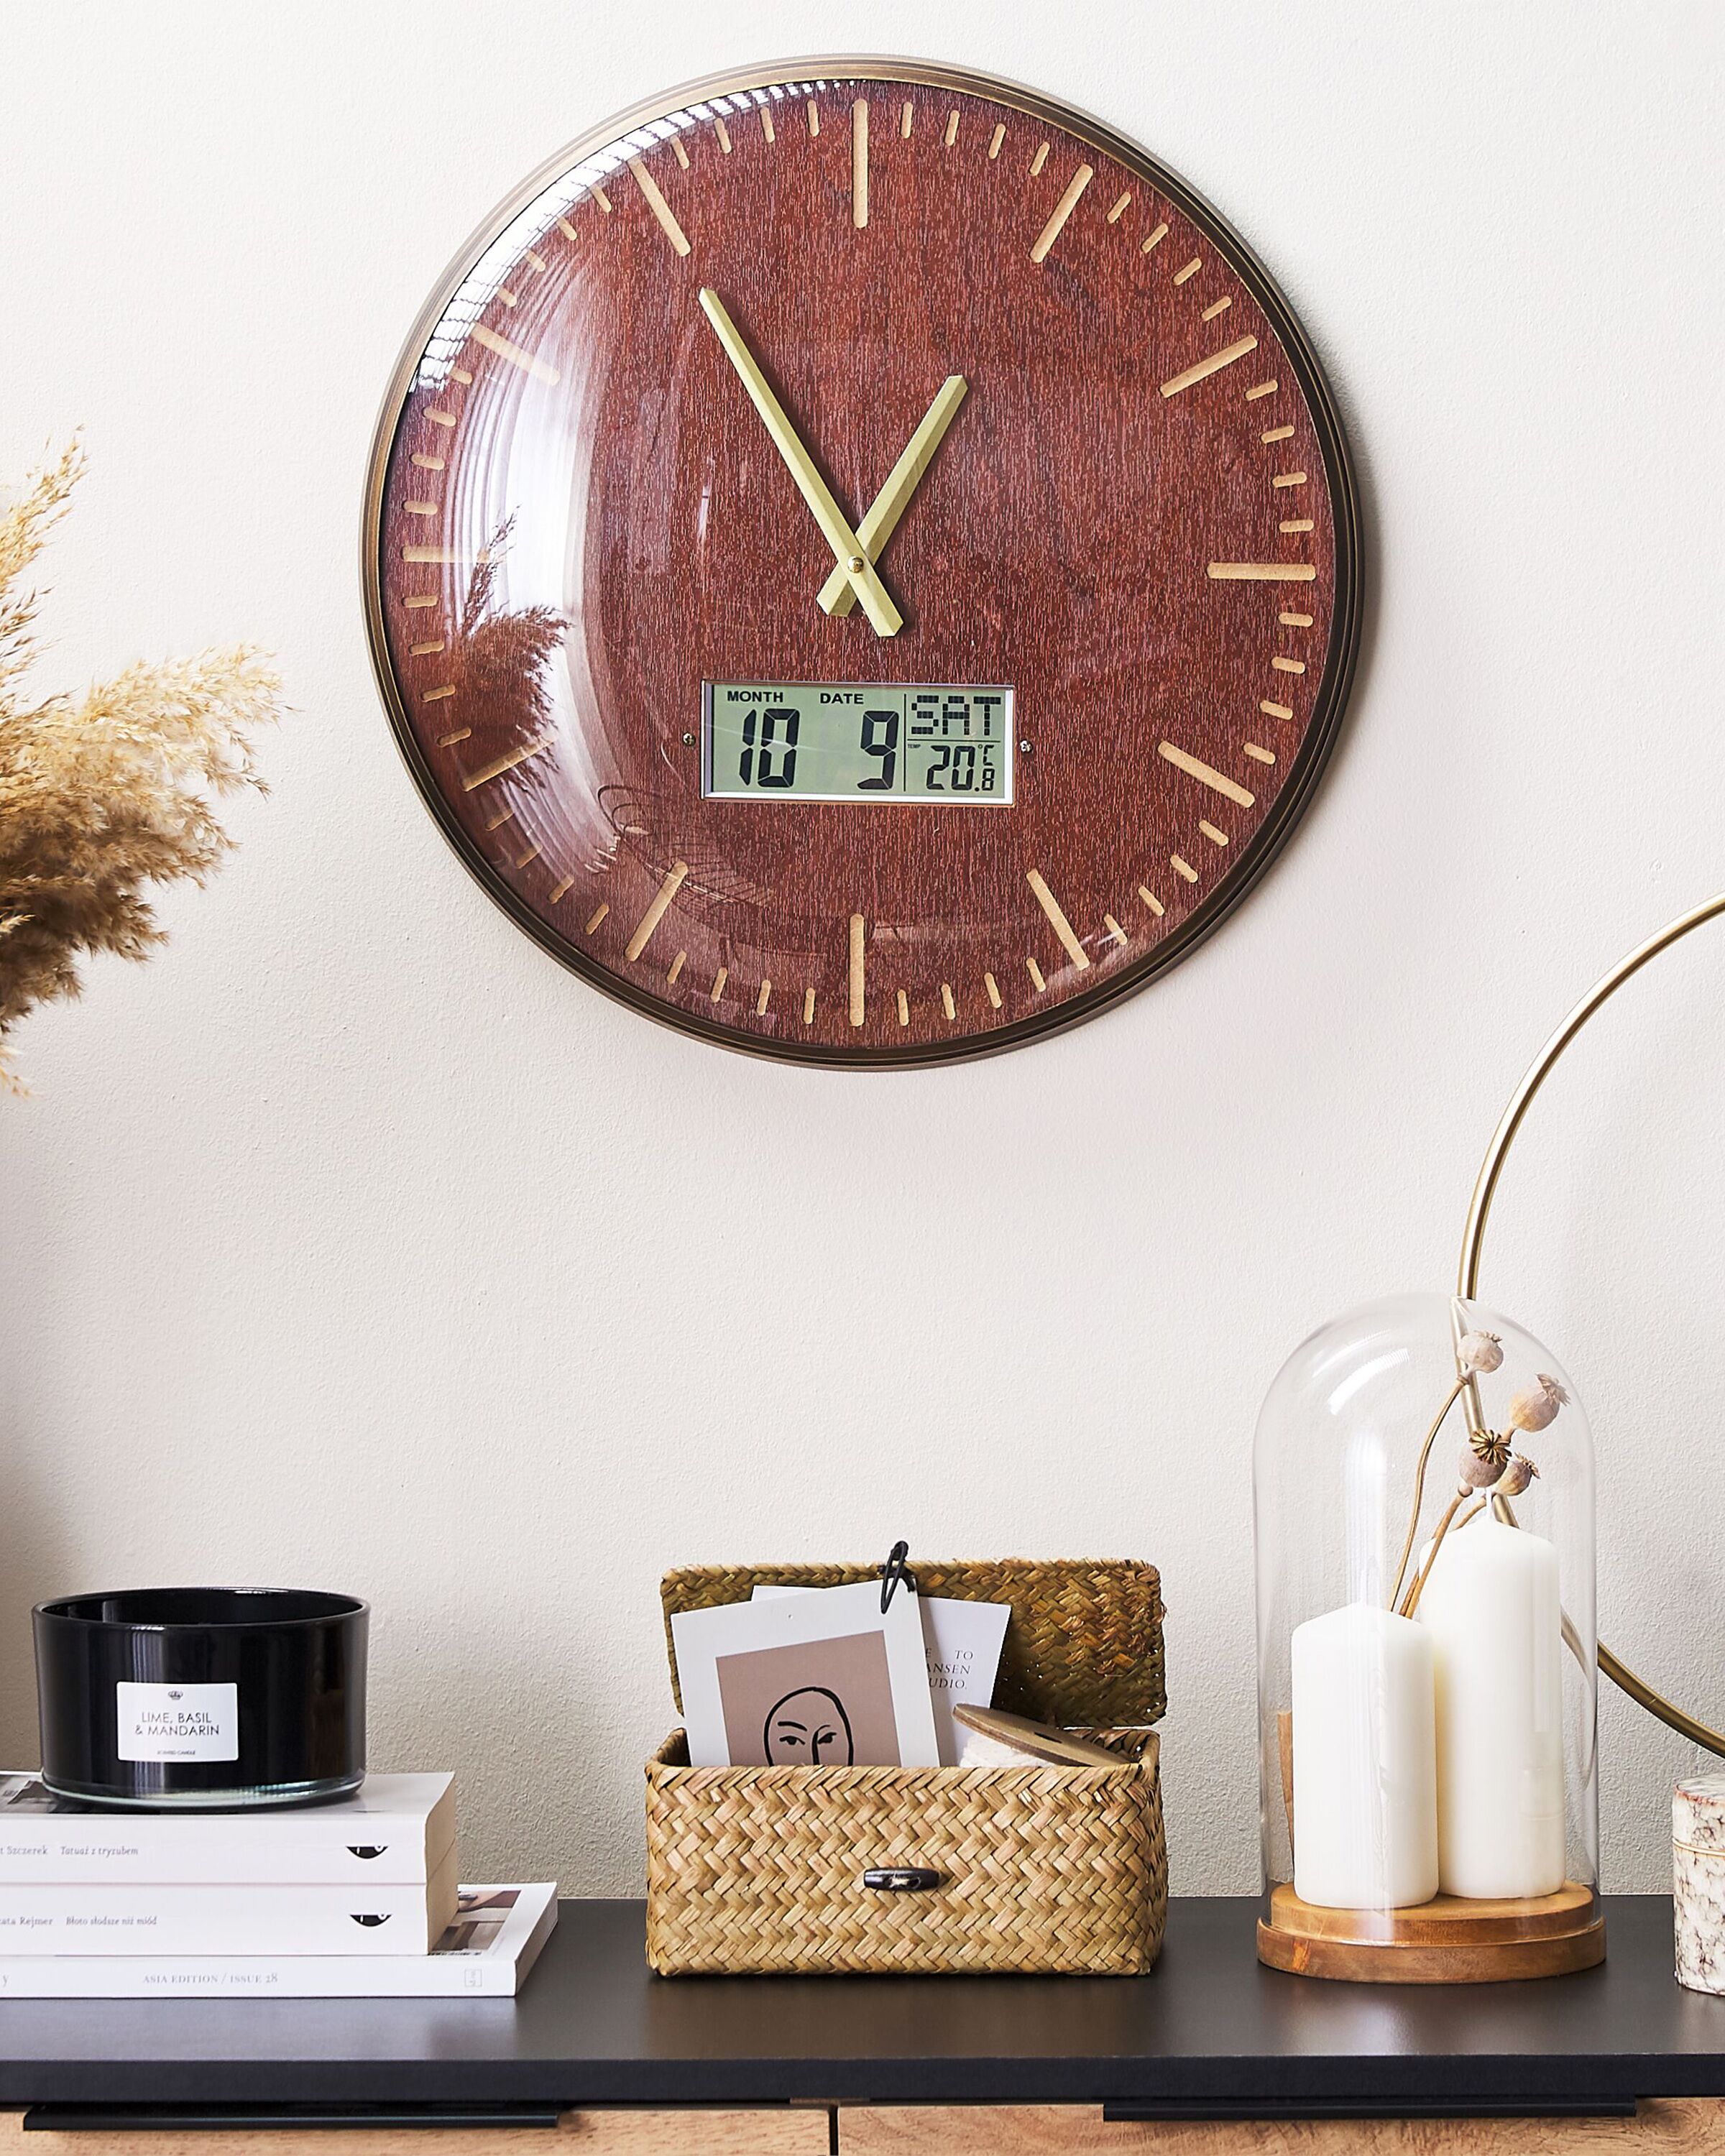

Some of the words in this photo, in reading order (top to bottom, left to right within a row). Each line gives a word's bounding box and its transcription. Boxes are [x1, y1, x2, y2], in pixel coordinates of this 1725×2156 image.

[727, 691, 784, 704] MONTH
[819, 693, 865, 705] DATE
[911, 694, 1001, 736] SAT
[738, 708, 801, 788] 10
[856, 710, 900, 791] 9
[954, 1649, 974, 1661] TO
[141, 1712, 173, 1724] LIME,
[178, 1712, 213, 1723] BASIL
[135, 1725, 143, 1735] &
[148, 1725, 220, 1736] MANDARIN
[142, 1974, 168, 1984] ASIA
[171, 1974, 218, 1984] EDITION
[230, 1974, 262, 1984] ISSUE
